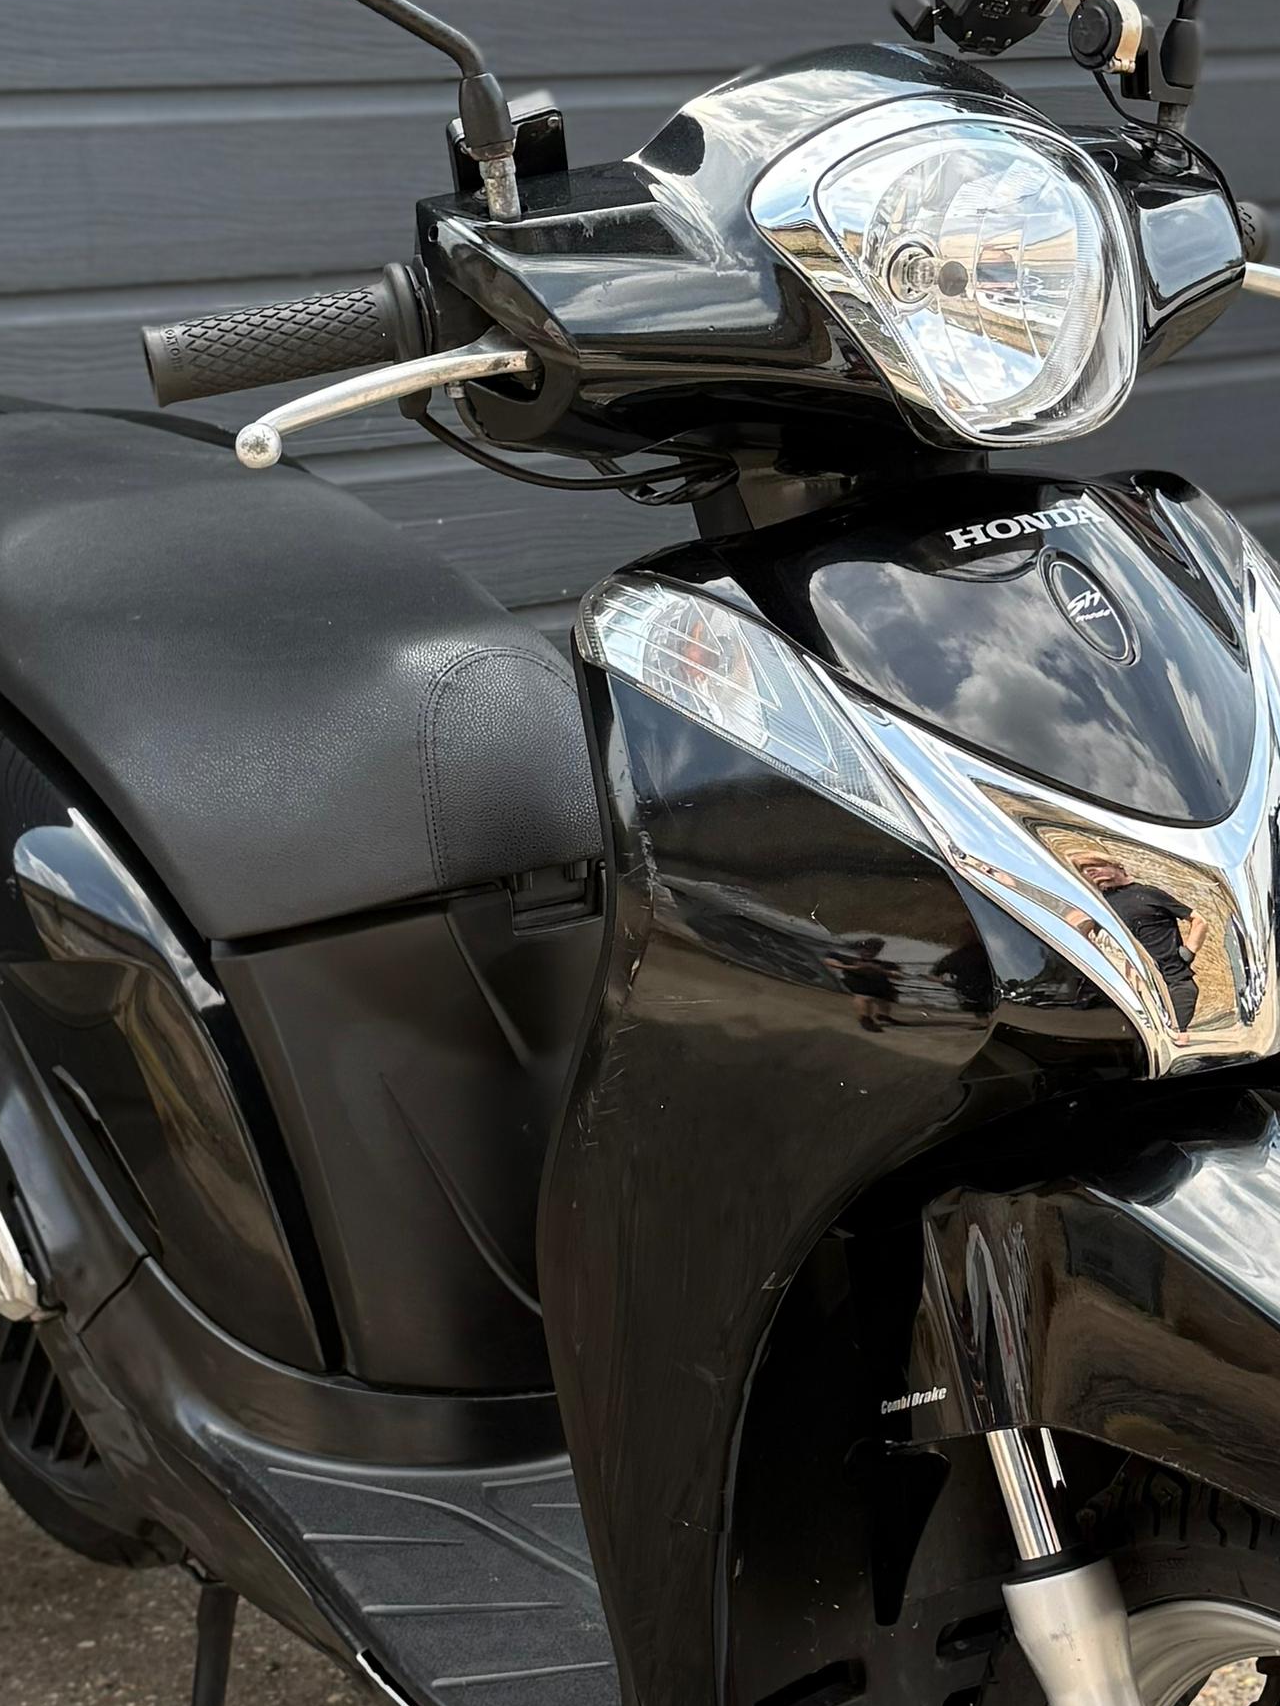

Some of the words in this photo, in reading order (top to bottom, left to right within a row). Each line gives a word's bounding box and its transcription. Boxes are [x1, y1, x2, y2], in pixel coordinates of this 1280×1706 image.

[945, 506, 1105, 550] HONDA
[1067, 590, 1101, 618] SH
[881, 1394, 911, 1414] Combi
[911, 1386, 947, 1407] Brake
